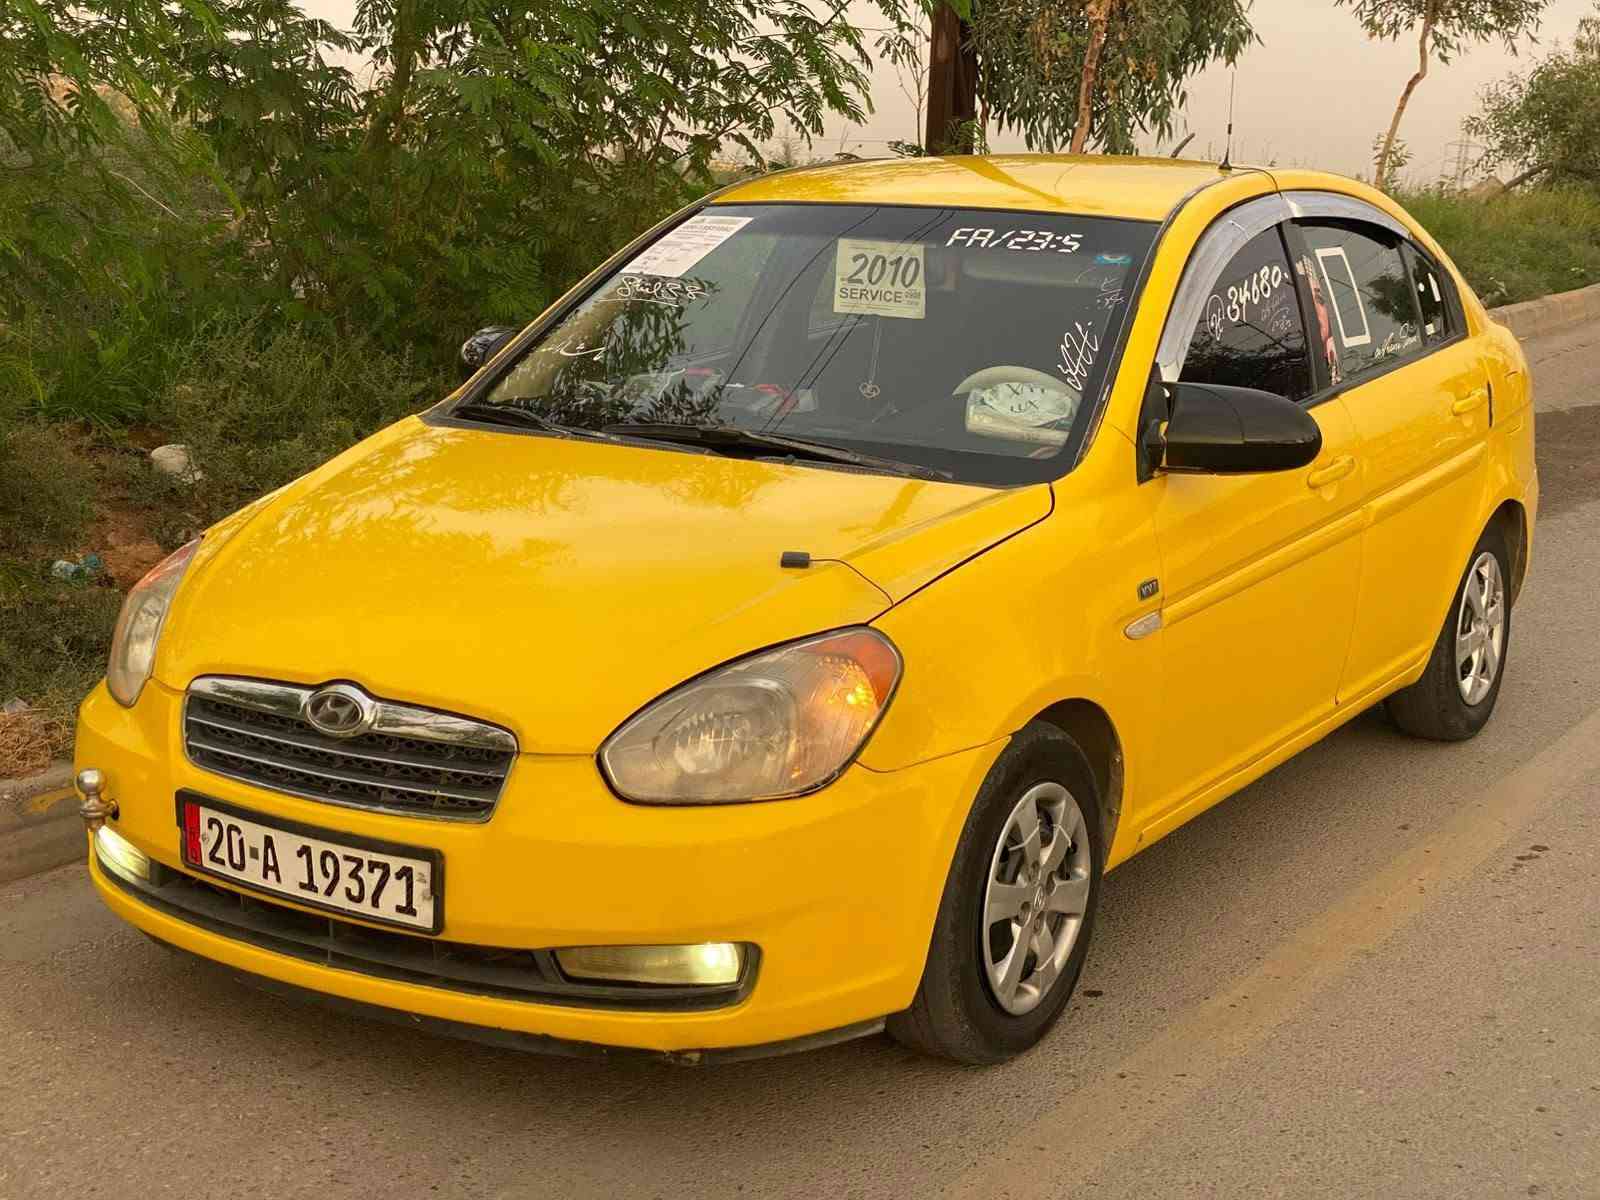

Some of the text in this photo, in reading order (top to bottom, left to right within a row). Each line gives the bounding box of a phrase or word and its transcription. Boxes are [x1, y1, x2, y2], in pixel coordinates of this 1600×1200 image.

[847, 253, 920, 288] 2010
[839, 287, 902, 303] SERVICE
[296, 843, 417, 917] 19371
